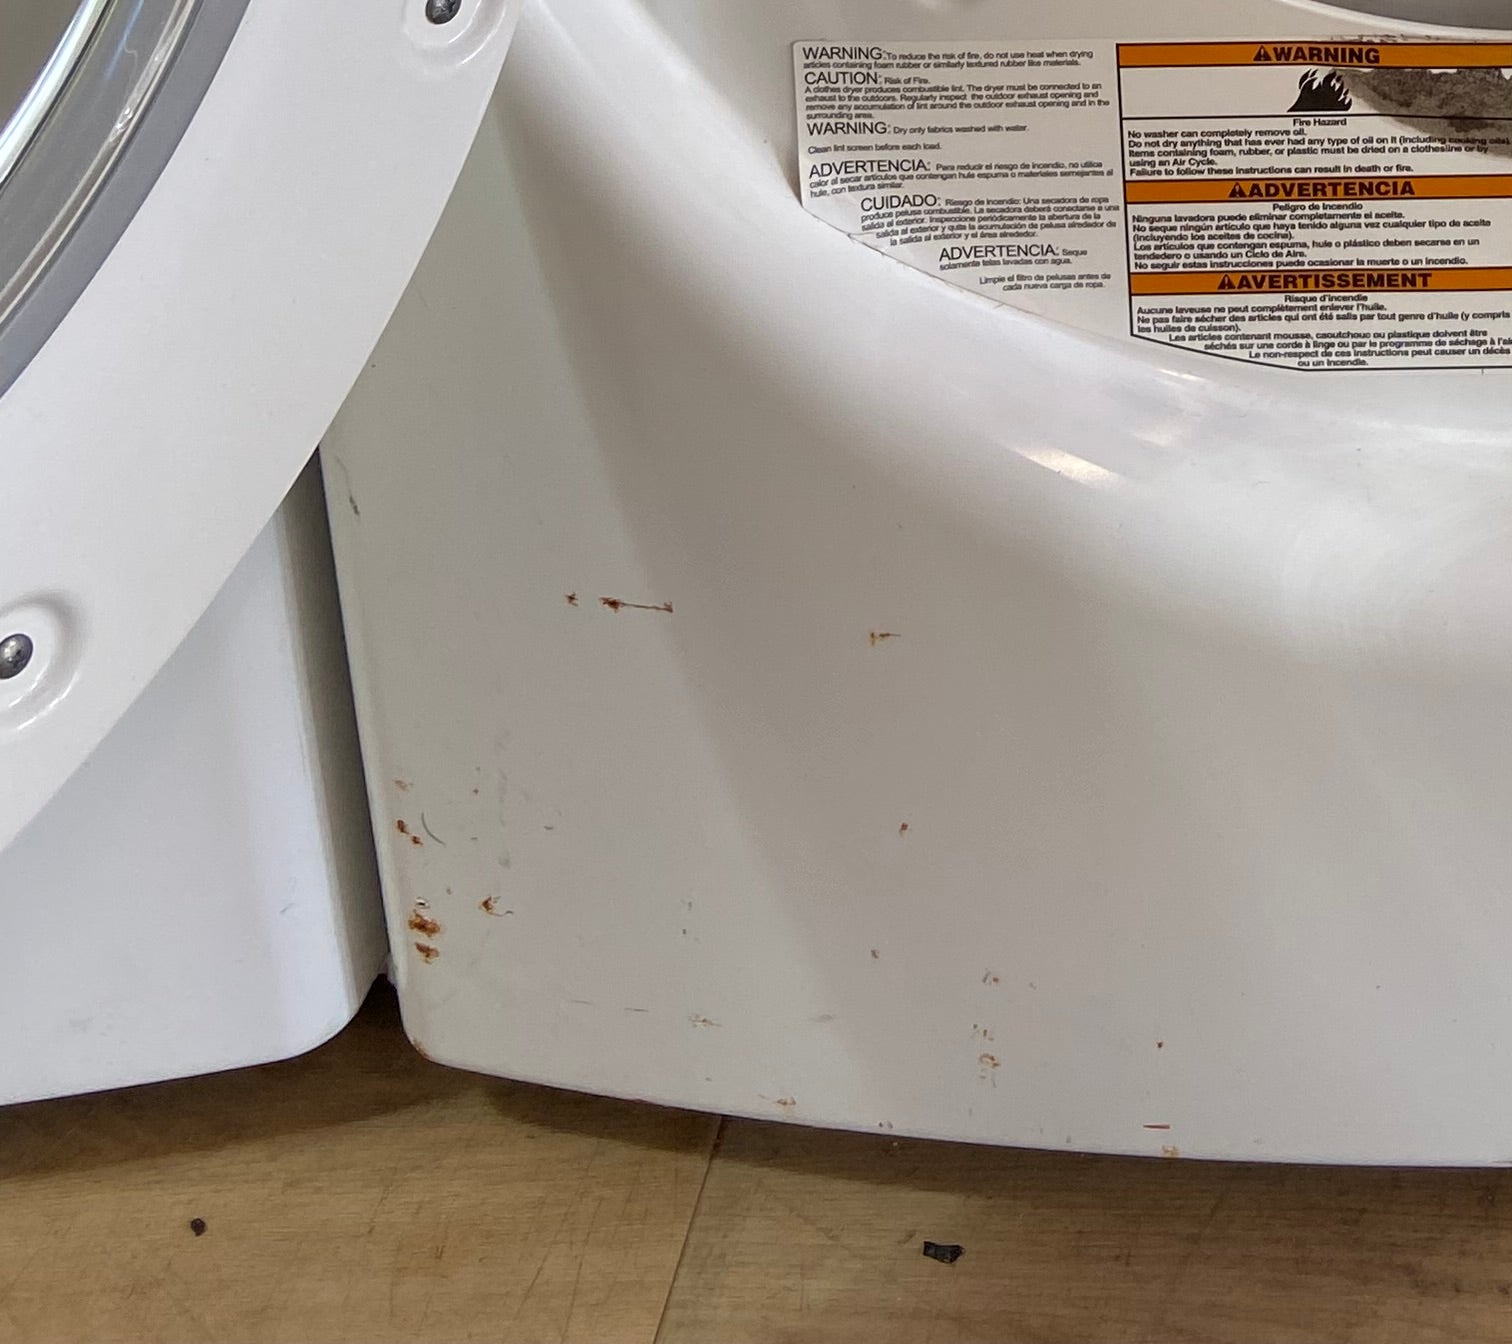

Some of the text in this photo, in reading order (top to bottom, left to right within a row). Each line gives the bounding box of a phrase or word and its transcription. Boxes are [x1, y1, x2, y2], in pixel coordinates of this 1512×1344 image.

[802, 46, 887, 60] WARNING:
[1273, 46, 1380, 64] WARNING
[804, 71, 882, 85] CAUTION:
[807, 122, 891, 136] WARNING:
[1293, 118, 1347, 126] Fire Hazard
[1127, 130, 1141, 139] No
[1144, 130, 1179, 138] washer
[1200, 129, 1252, 139] completely
[808, 146, 832, 154] Clean
[833, 144, 845, 152] lint
[875, 143, 900, 151] before
[902, 143, 921, 151] each
[923, 142, 941, 150] load.
[809, 159, 931, 179] ADVERTENCIA:
[1129, 157, 1218, 168] using an Air Cycle.
[1129, 167, 1162, 177] Failure
[1164, 168, 1175, 176] to
[1176, 167, 1205, 176] follow
[1207, 167, 1234, 175] these
[1235, 166, 1292, 175] instructions
[1314, 165, 1341, 173] result
[1343, 165, 1352, 173] in
[1354, 164, 1381, 173] death
[1395, 164, 1414, 172] fire.
[1249, 180, 1416, 198] ADVERTENCIA
[860, 194, 941, 212] CUIDADO:
[1273, 202, 1363, 213] Peligro de Incendio
[938, 244, 1059, 262] ADVERTENCIA:
[1236, 272, 1432, 290] AVERTISSEMENT
[1284, 293, 1369, 304] Risque d'incendie
